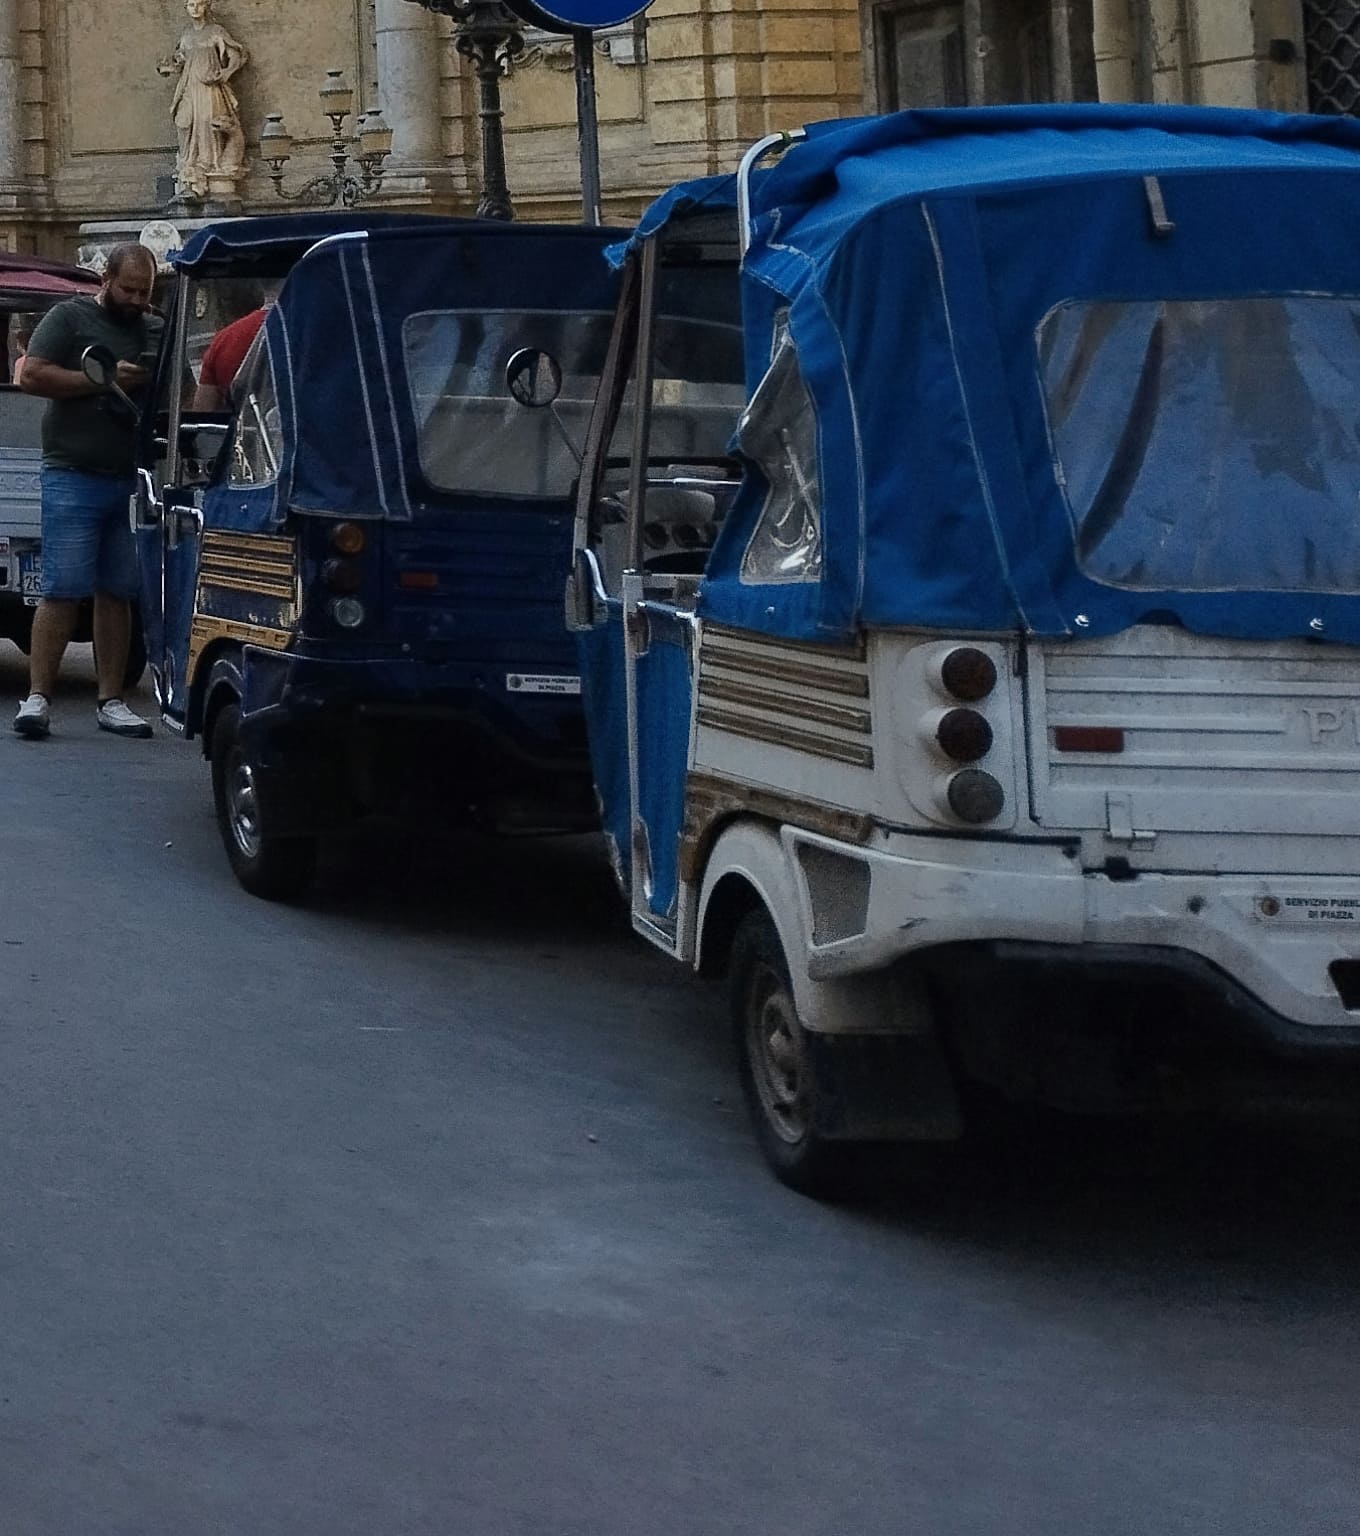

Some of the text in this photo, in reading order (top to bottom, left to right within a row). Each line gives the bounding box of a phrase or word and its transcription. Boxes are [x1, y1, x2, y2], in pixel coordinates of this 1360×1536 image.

[1285, 897, 1329, 907] SERVIZIO
[1307, 910, 1354, 920] DI PIAZZA
